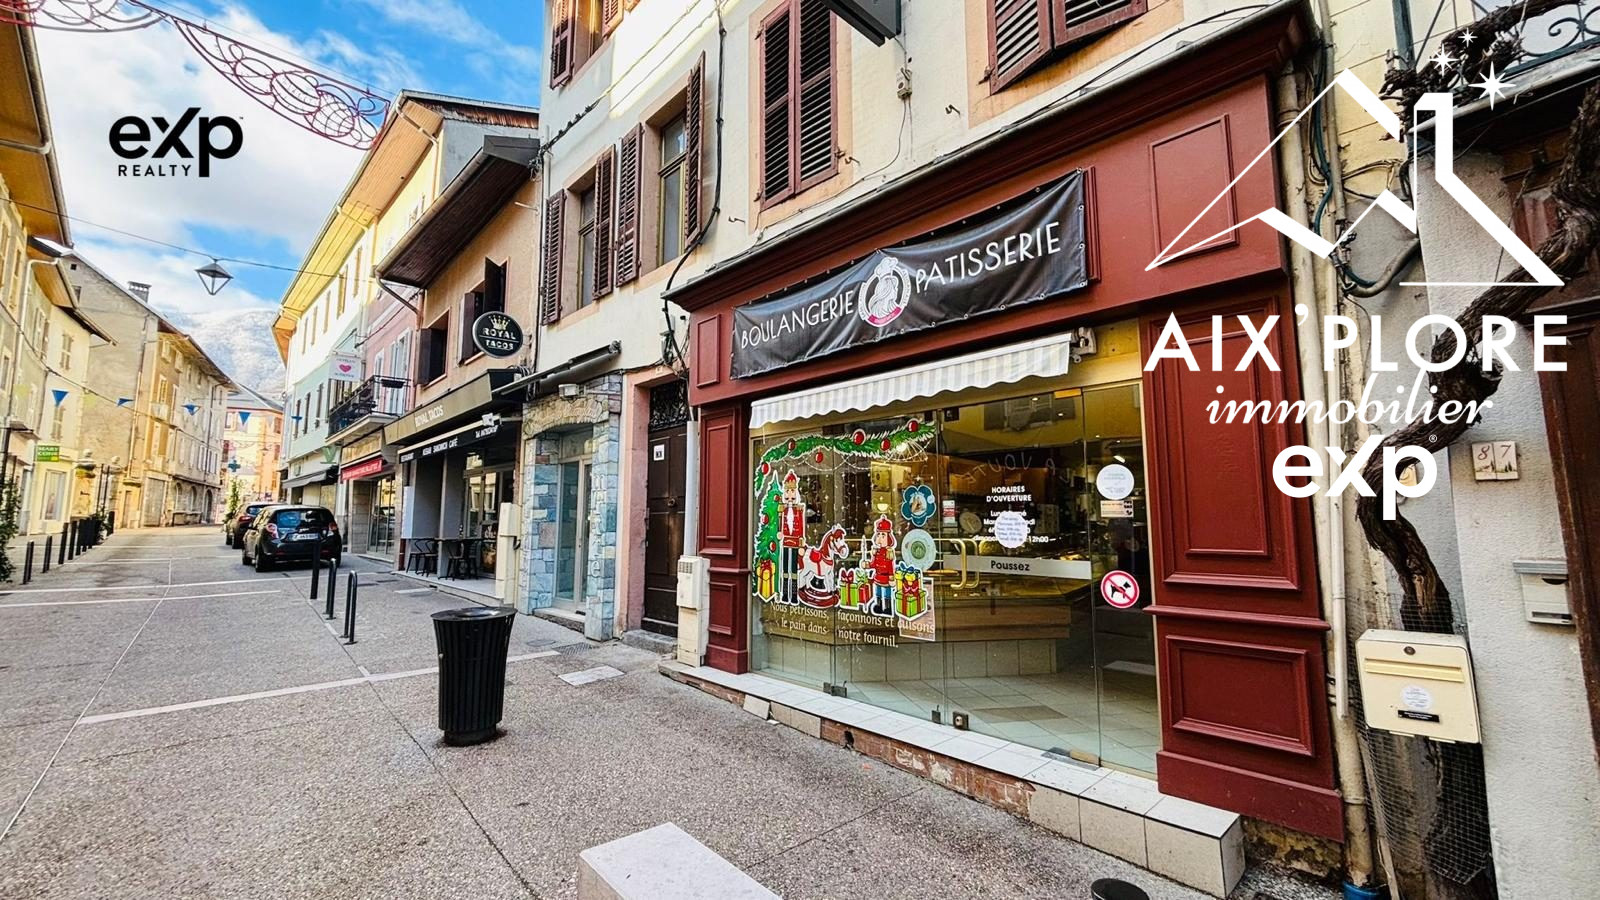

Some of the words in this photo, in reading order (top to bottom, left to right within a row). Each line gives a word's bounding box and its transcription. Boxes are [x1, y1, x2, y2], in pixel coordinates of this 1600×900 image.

[740, 290, 854, 349] BOULANGERIE
[914, 221, 1062, 294] PATISSERIE
[482, 327, 516, 340] ROYAL
[485, 339, 514, 350] TACOS
[428, 404, 444, 421] TACOS
[991, 485, 1026, 494] HORAIRES
[986, 494, 1032, 503] D'OUVERTURE
[990, 560, 1031, 572] Poussez
[770, 600, 788, 612] Nous
[837, 609, 882, 626] façonnons
[884, 616, 895, 628] et
[897, 619, 936, 634] cuisons
[781, 617, 788, 628] le
[789, 620, 806, 632] pain
[807, 621, 827, 635] dans
[838, 629, 861, 641] notre
[863, 631, 900, 648] fournil.
